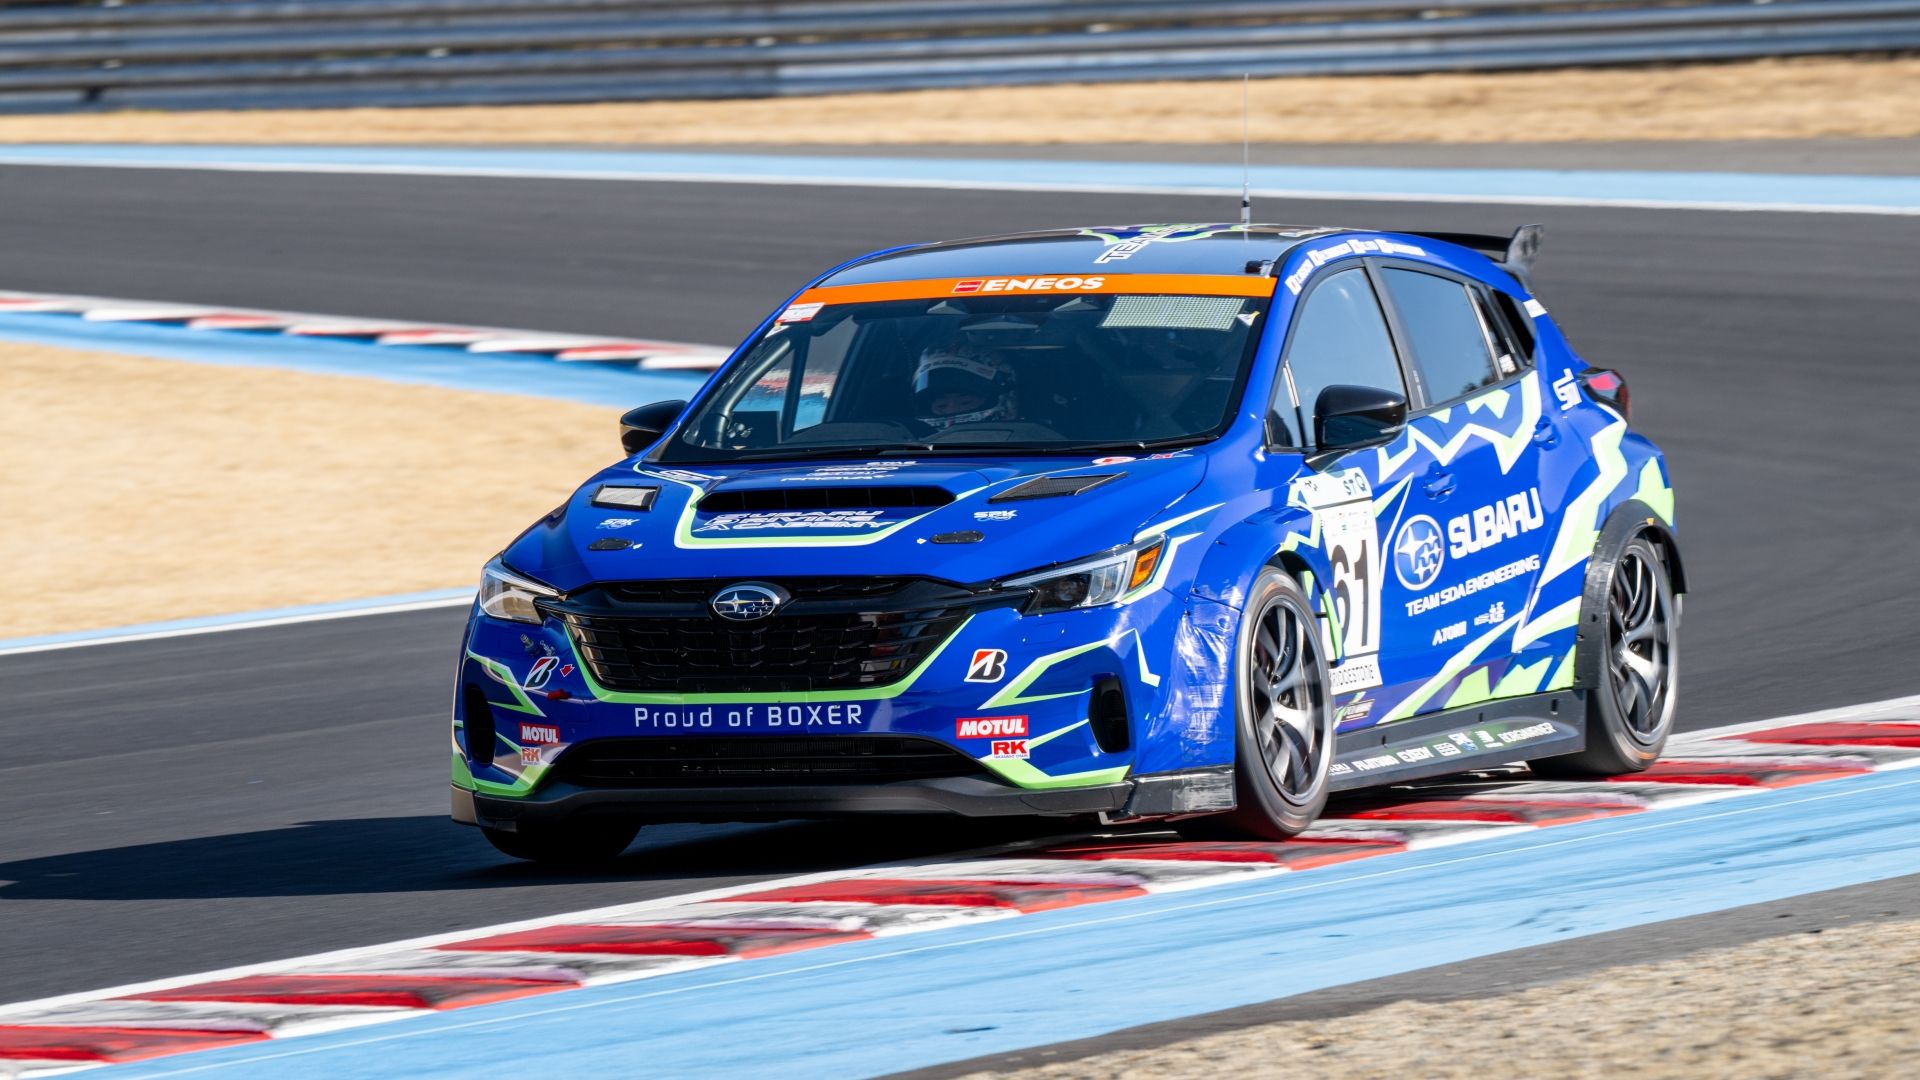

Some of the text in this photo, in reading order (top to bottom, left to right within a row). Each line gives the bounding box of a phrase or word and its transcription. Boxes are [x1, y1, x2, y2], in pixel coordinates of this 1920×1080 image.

[982, 276, 1105, 292] ENEOS
[1447, 487, 1545, 560] SUBARU
[1330, 539, 1369, 648] 61
[1405, 554, 1541, 617] TEAM SDA ENGINEERING
[634, 704, 863, 728] Proud of BOXER
[521, 725, 559, 744] MOTUL
[959, 718, 1026, 737] MOTUL
[522, 747, 540, 762] RK
[993, 740, 1027, 755] RK
